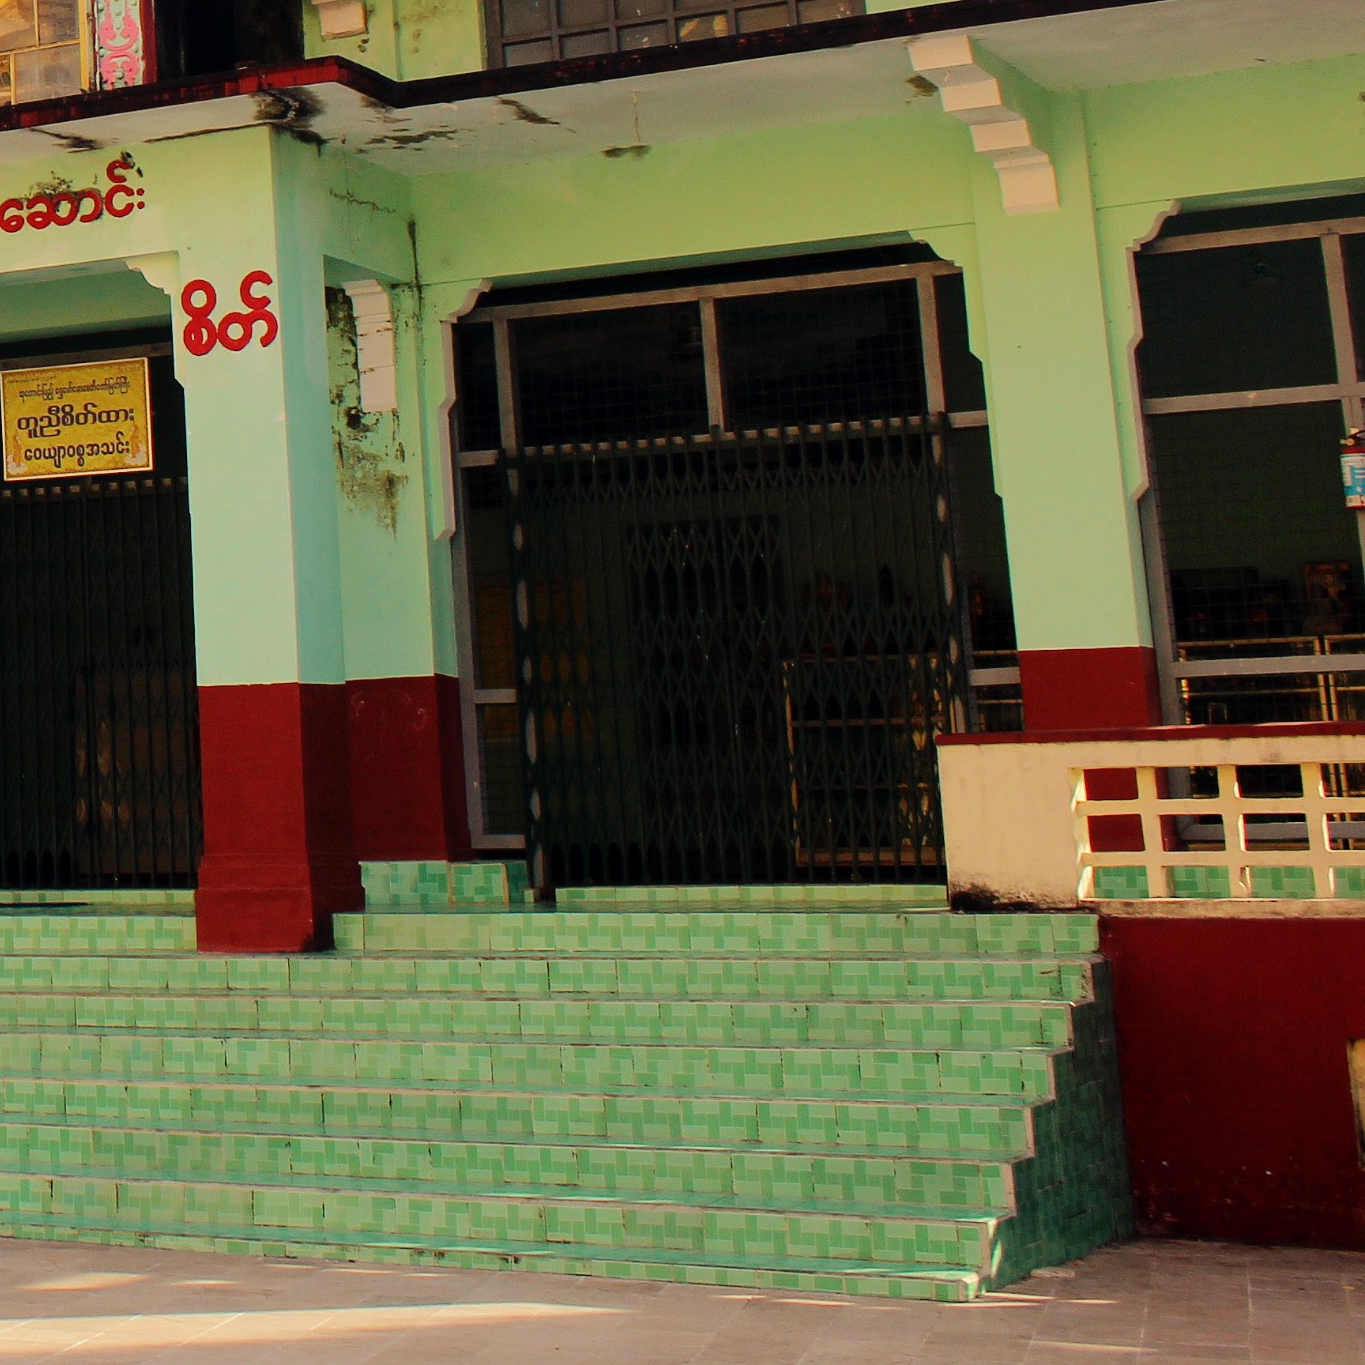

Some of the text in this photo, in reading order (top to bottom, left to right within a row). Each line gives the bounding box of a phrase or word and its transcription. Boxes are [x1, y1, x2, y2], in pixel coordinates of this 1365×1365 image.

[181, 270, 278, 356] စိတ်
[17, 402, 135, 439] တူညီစိတ်ထား
[24, 431, 131, 468] ဝေယျာဝစ္စအသင်း
